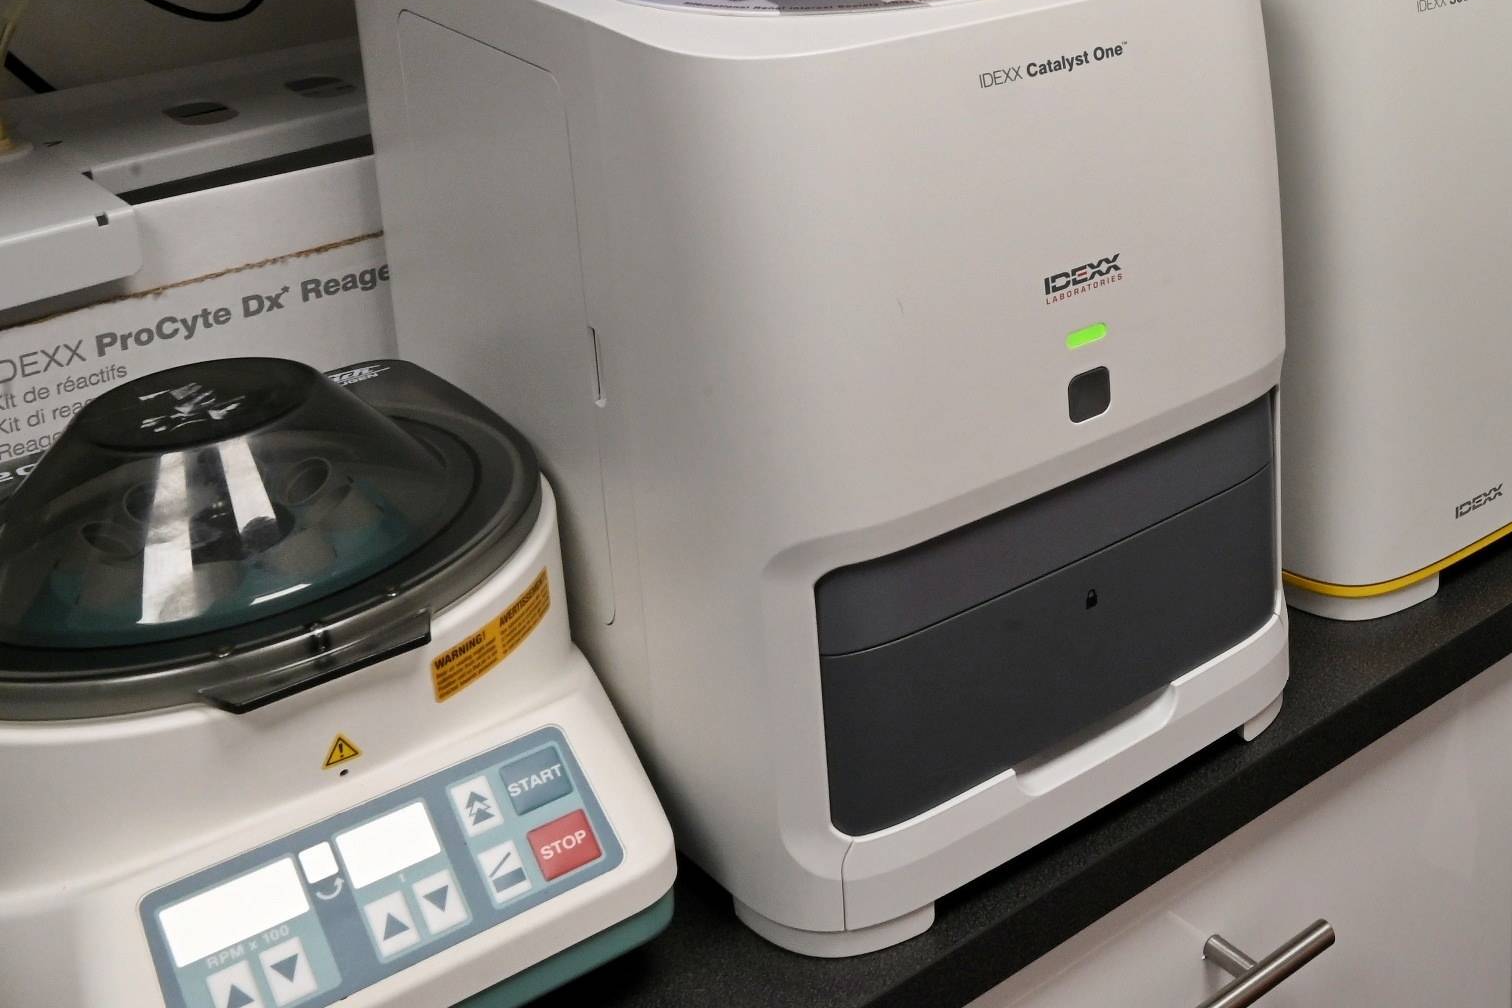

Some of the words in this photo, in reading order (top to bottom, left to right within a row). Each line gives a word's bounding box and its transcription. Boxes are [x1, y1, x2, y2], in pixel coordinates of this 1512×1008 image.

[978, 65, 1024, 89] IDEXX
[1025, 51, 1091, 77] Catalyst
[1043, 252, 1122, 296] IDEXX
[1045, 273, 1124, 305] LABORATORIES
[94, 306, 233, 358] ProCyte
[23, 385, 51, 405] de
[56, 363, 128, 395] réactifs
[26, 408, 47, 428] di
[1455, 482, 1504, 520] IDEXX
[507, 763, 563, 798] START
[540, 829, 587, 861] STOP
[206, 946, 246, 970] RPM
[250, 939, 258, 951] x
[262, 924, 291, 944] 100
